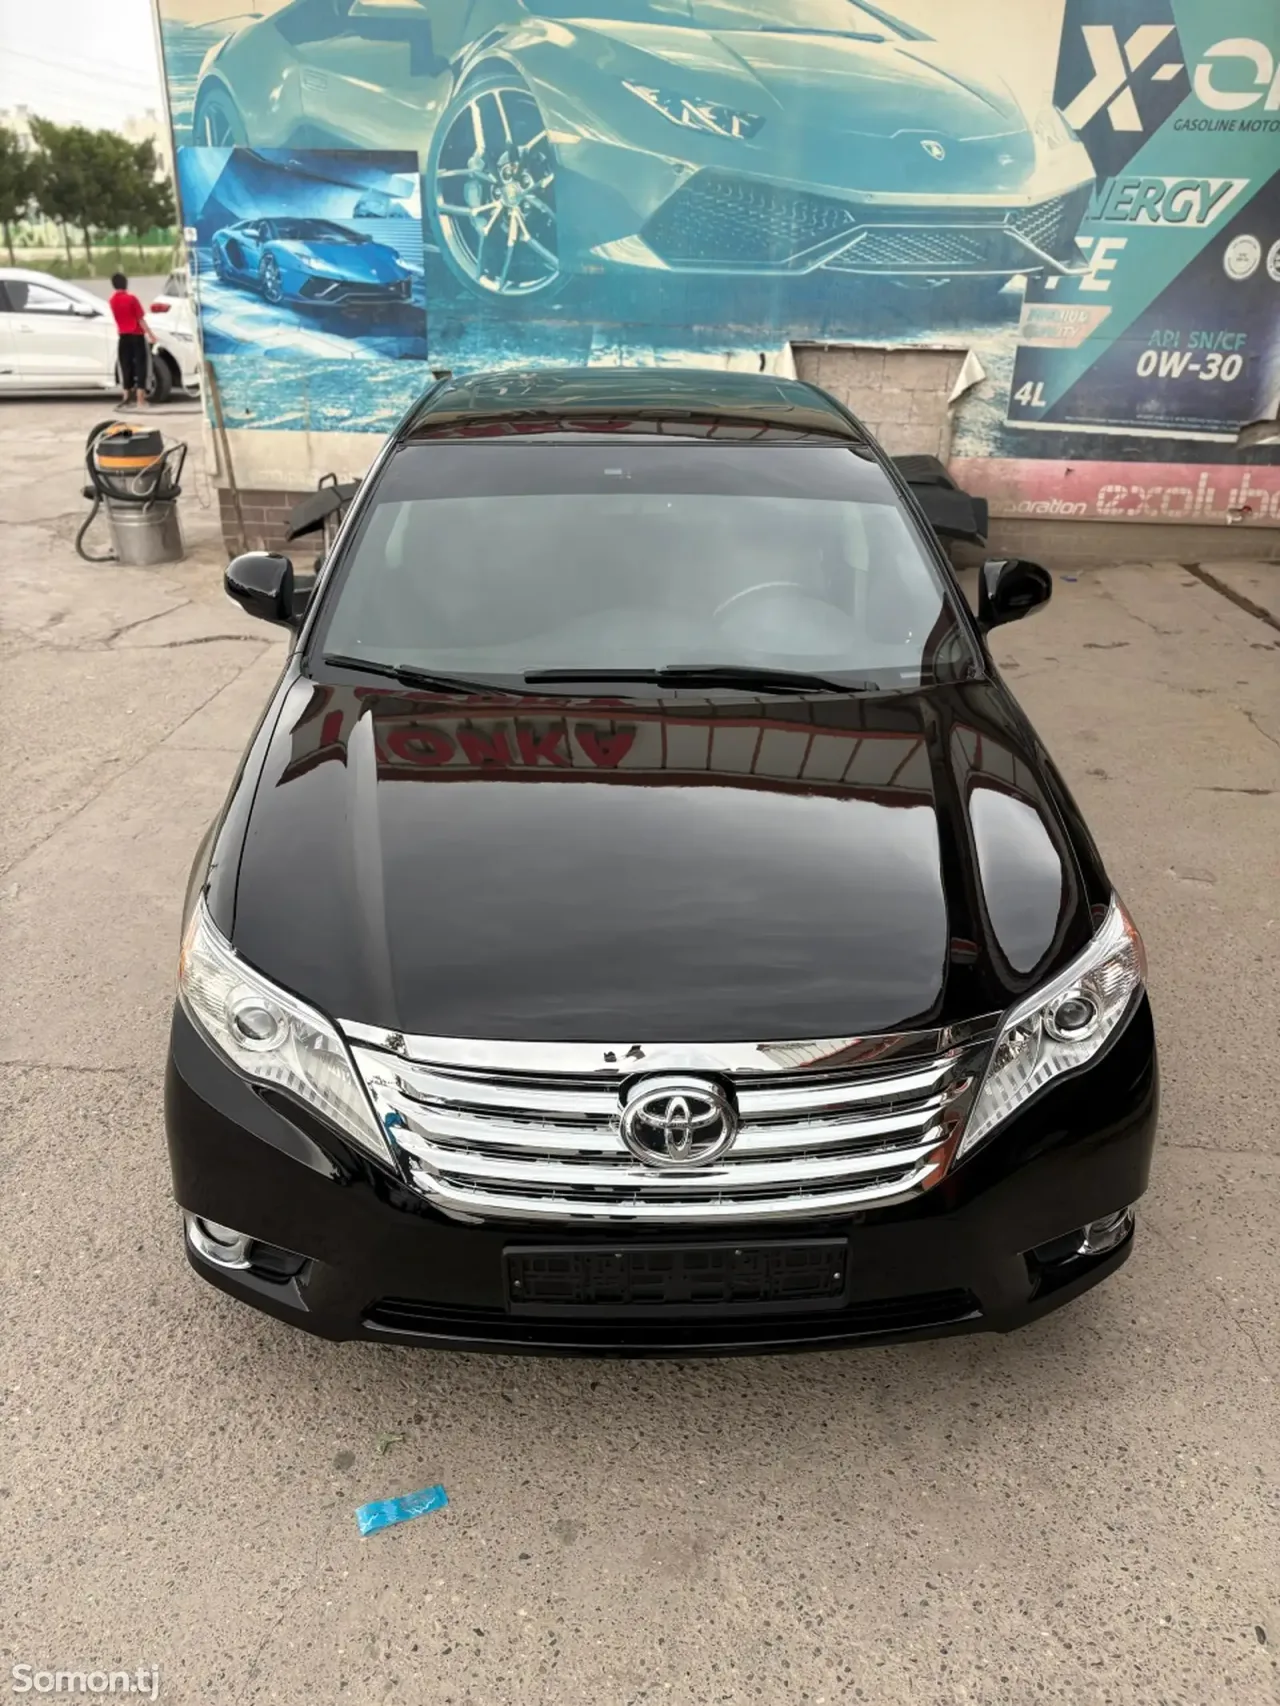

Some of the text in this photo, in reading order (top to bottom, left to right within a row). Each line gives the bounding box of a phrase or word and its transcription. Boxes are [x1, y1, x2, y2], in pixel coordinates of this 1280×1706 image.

[1173, 118, 1237, 132] GASOLINE
[1148, 329, 1247, 351] API SN/CF
[1136, 350, 1243, 382] 0W-30
[1014, 381, 1046, 407] 4L
